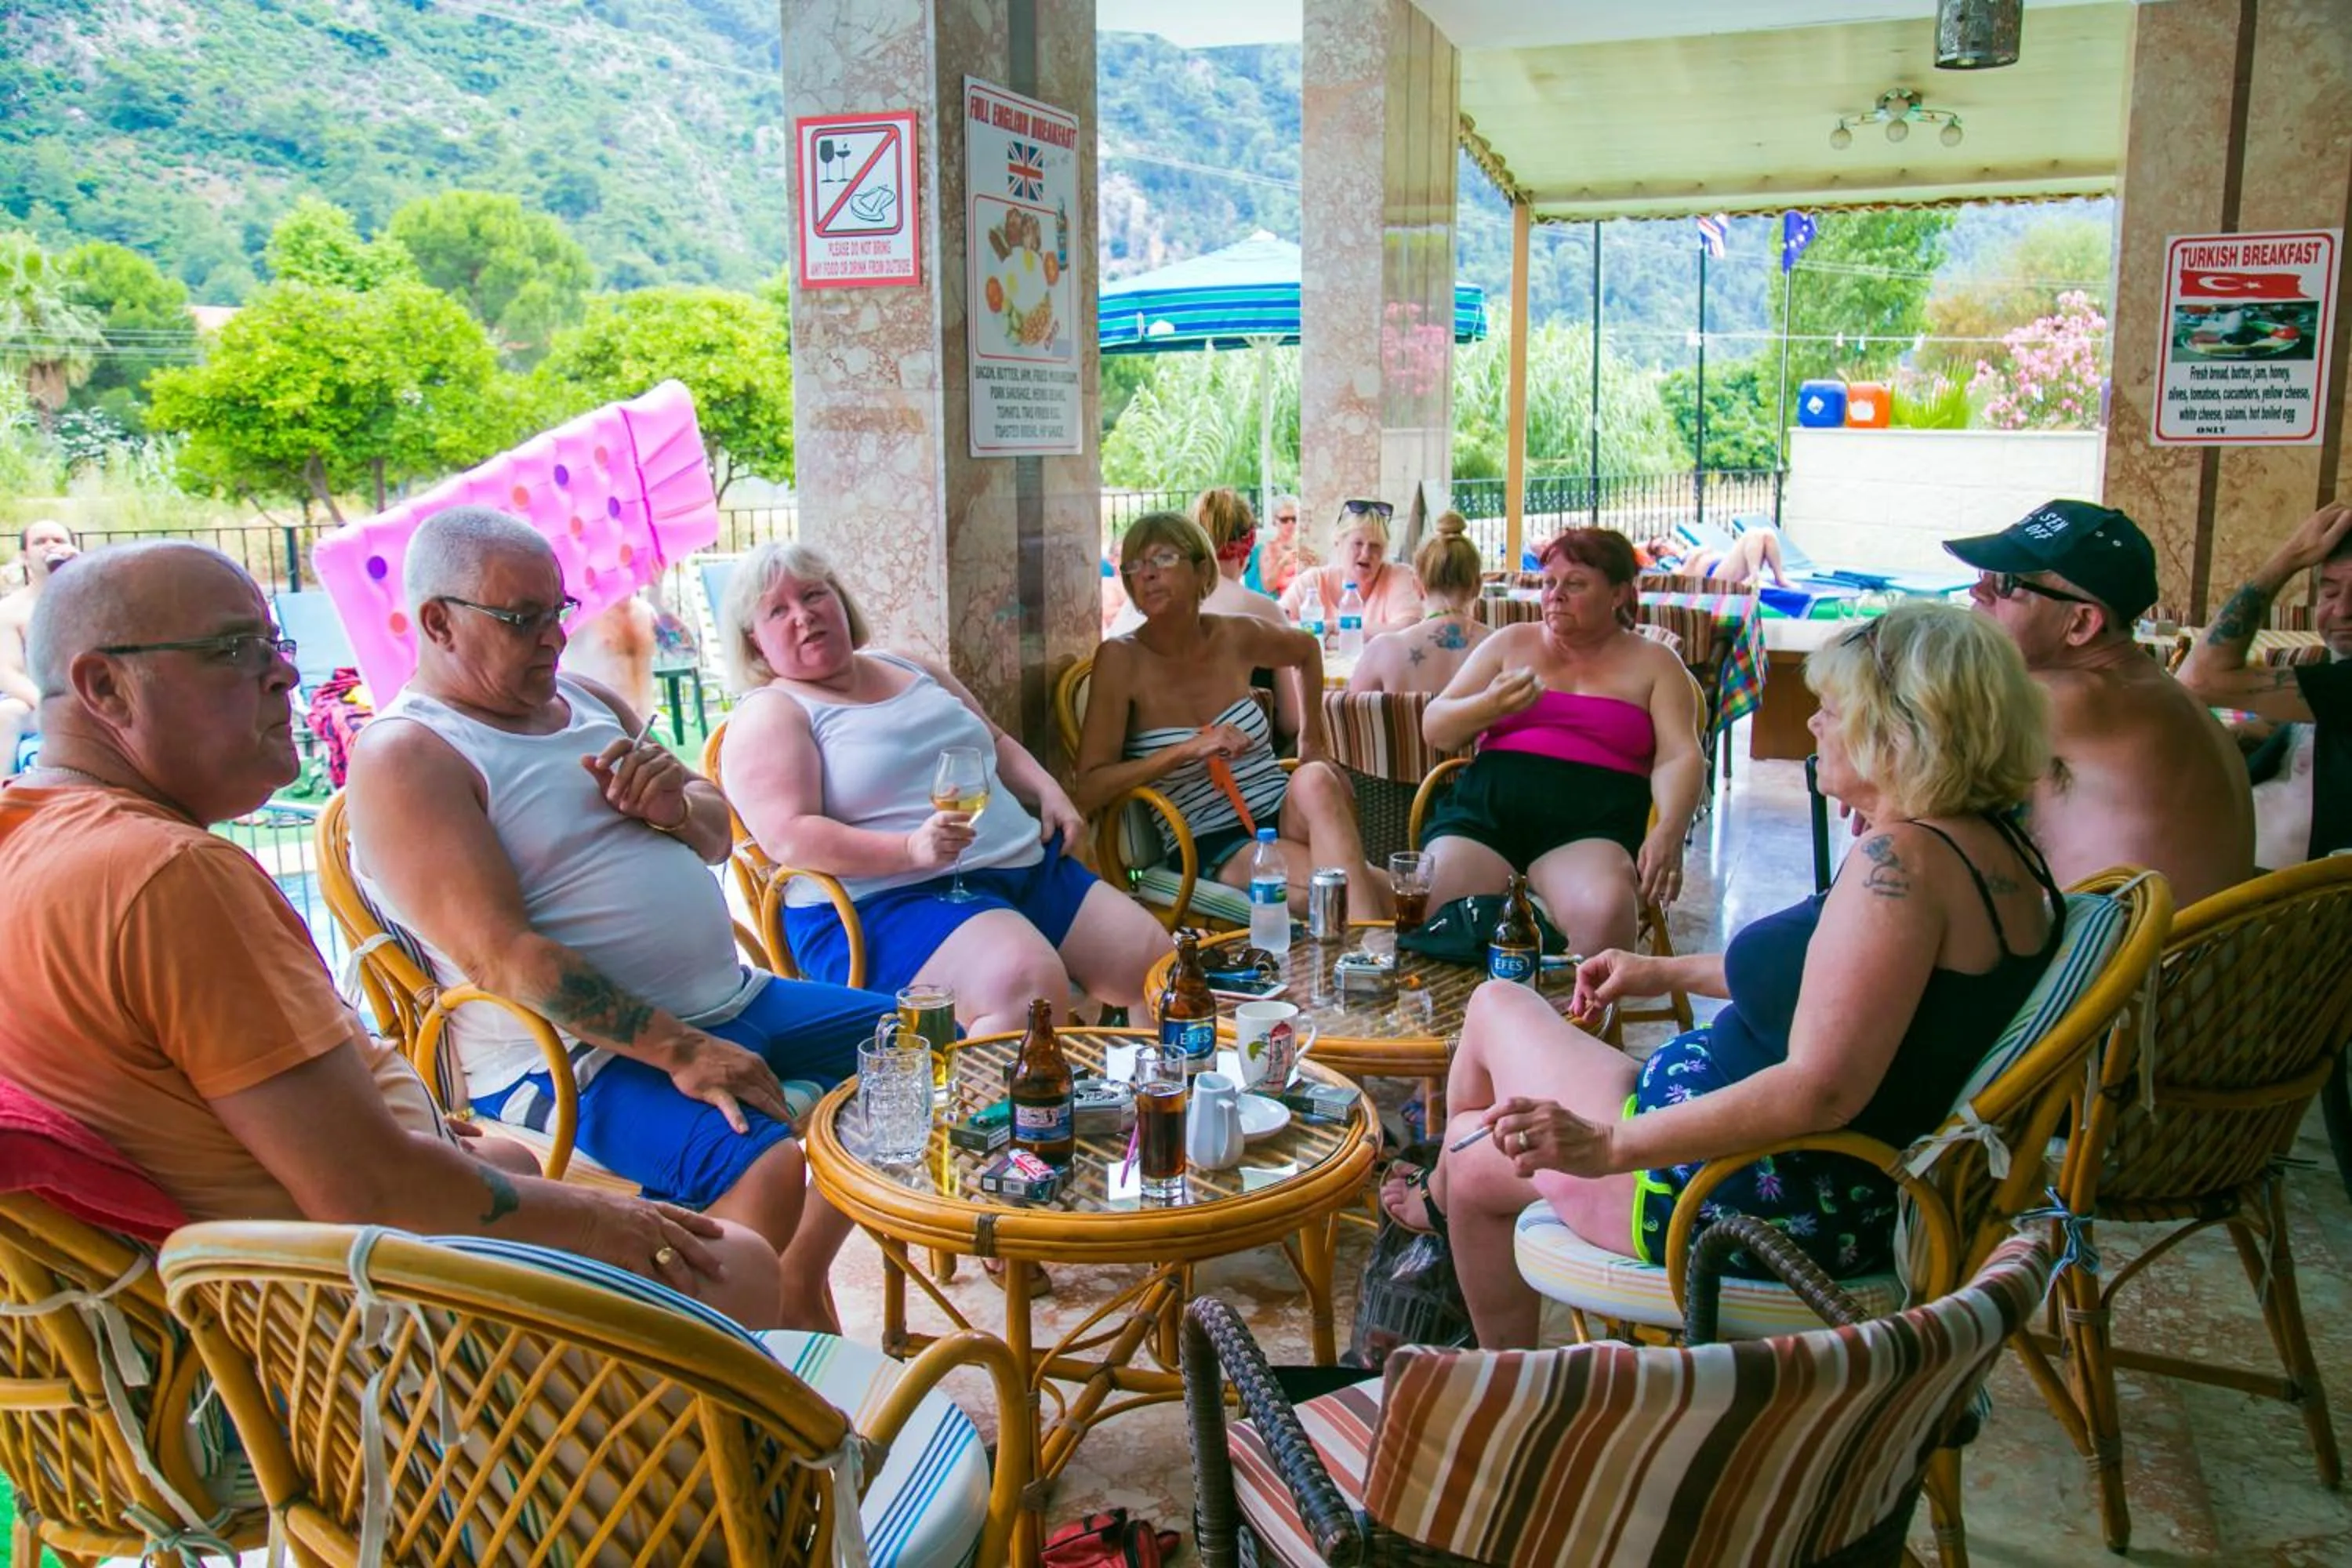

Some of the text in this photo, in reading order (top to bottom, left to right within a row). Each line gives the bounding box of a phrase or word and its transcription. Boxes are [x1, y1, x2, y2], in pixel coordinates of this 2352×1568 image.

[2180, 242, 2321, 268] TURKISH BREAKFAST
[2190, 365, 2208, 380] Fresh
[2168, 385, 2310, 402] olives, tomatoes, cucumbers, yellow cheese,
[2179, 406, 2296, 423] white cheese, salami, hot boiled egg
[2196, 426, 2227, 434] ONLY
[1495, 957, 1523, 971] EFES
[1180, 1029, 1211, 1045] EFES
